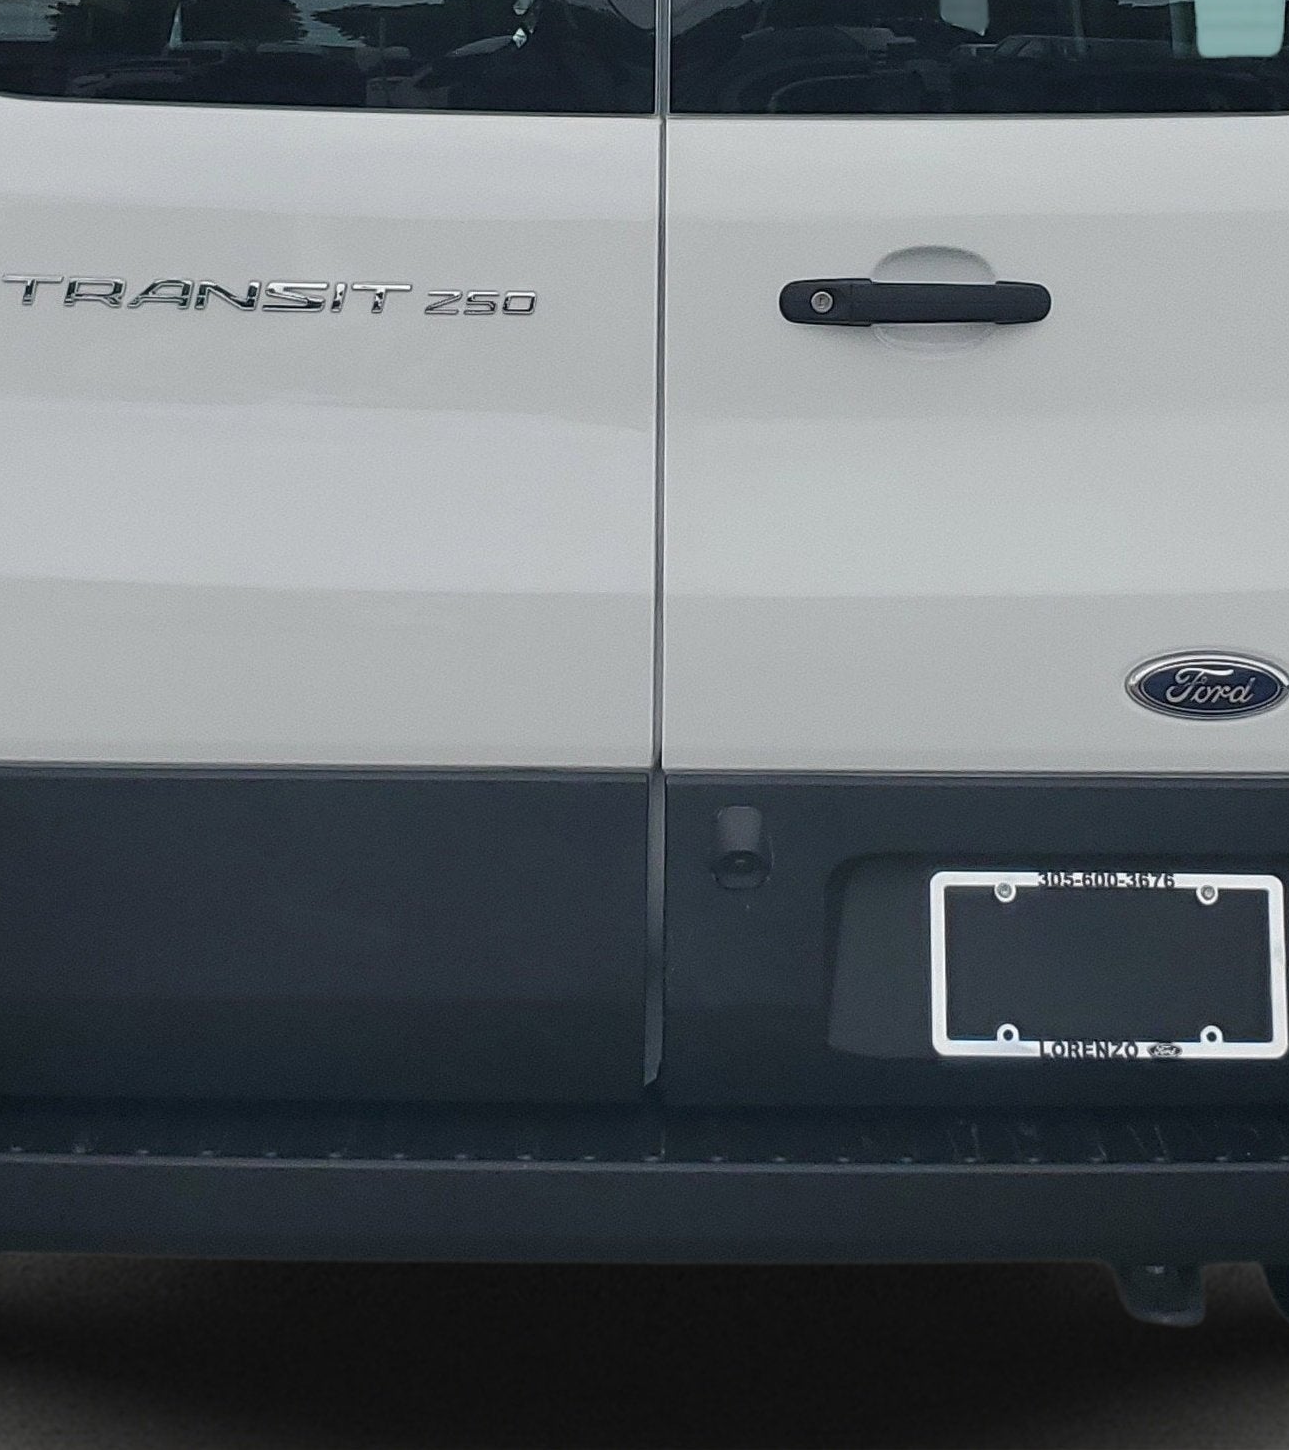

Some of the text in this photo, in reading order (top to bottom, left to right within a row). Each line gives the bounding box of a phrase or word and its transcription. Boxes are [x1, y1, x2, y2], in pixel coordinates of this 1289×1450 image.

[2, 273, 538, 317] TRANSIT 250
[1165, 666, 1257, 704] Ford
[1037, 871, 1176, 889] 305-600-3676
[1039, 1040, 1140, 1059] LORENZO
